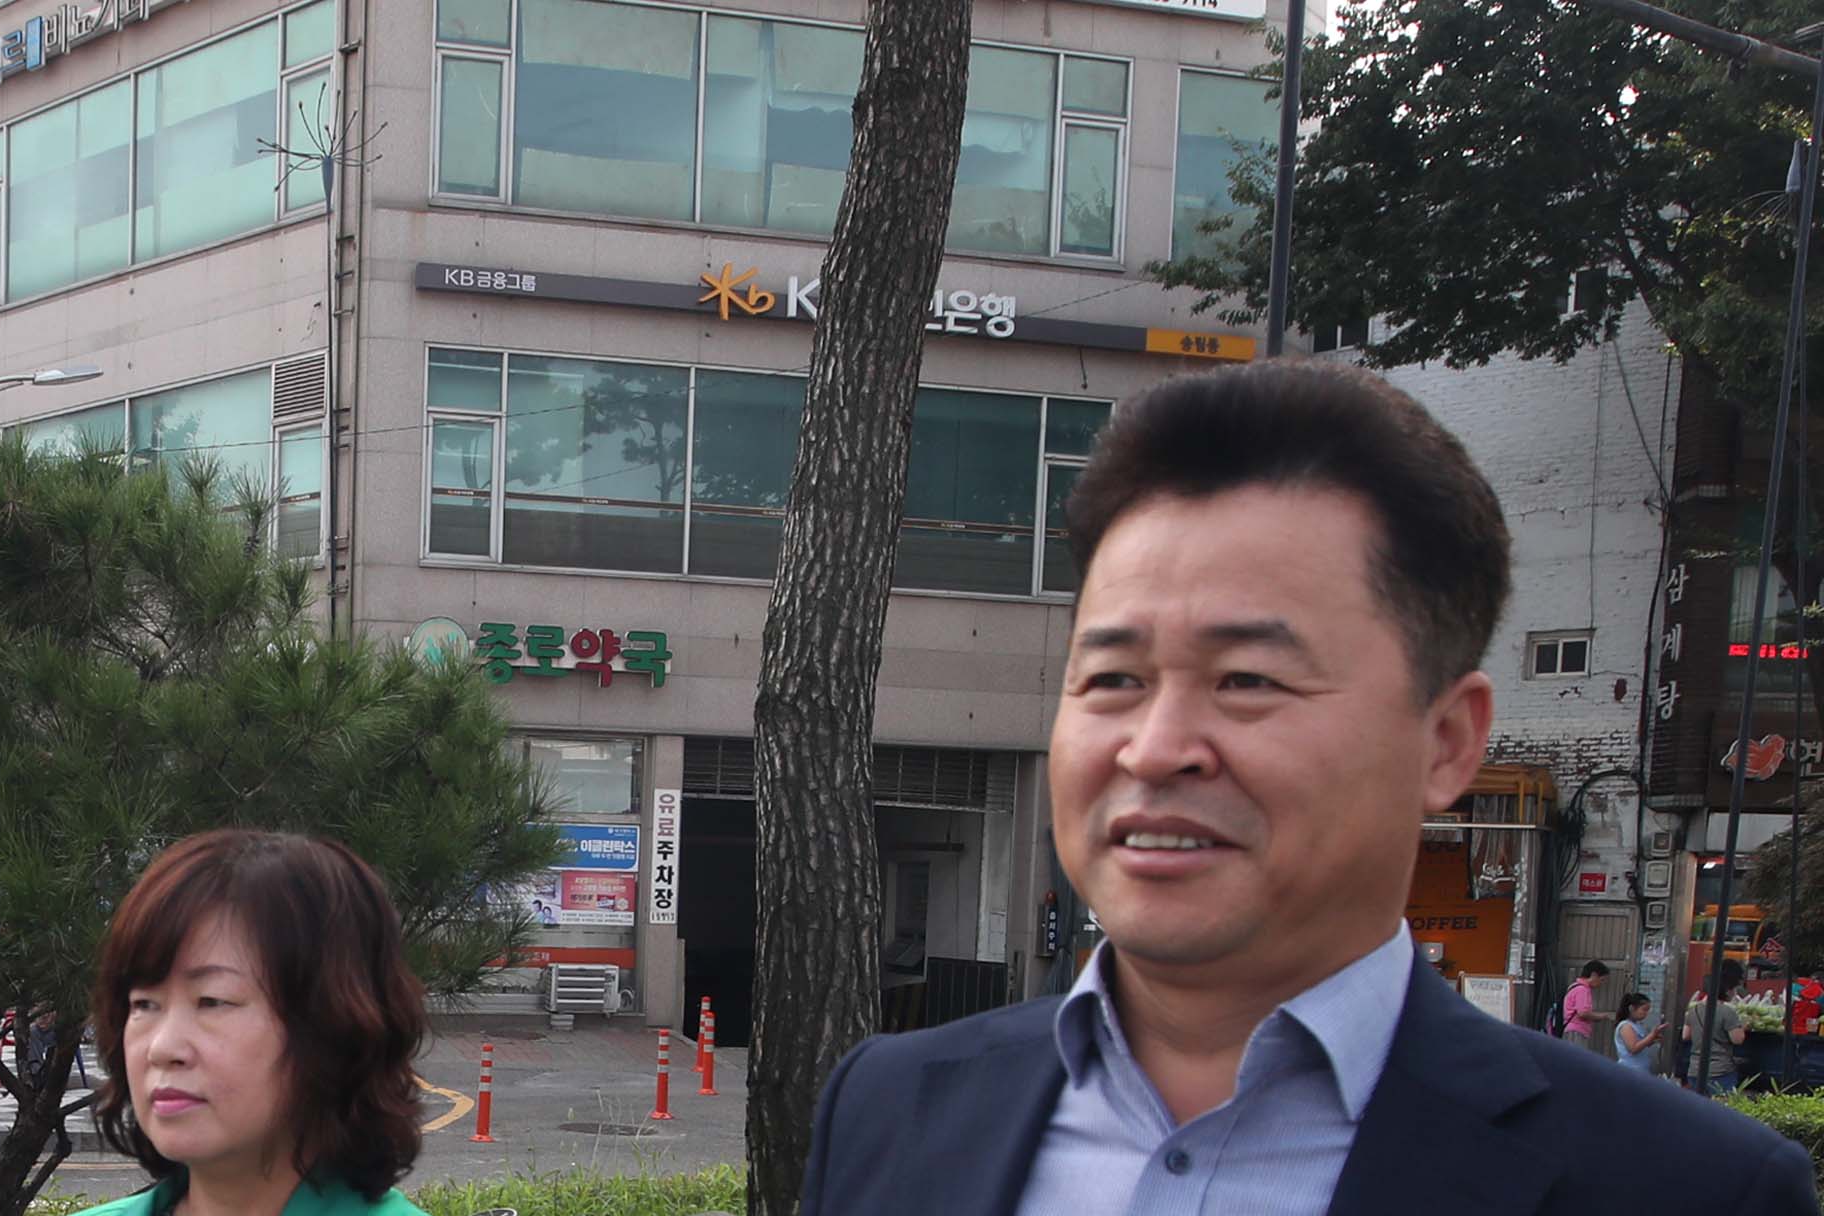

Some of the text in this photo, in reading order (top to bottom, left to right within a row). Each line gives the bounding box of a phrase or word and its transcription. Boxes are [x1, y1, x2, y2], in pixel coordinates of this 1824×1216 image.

[444, 268, 537, 292] KB금융그룹
[475, 622, 673, 689] 종로약국
[1658, 564, 1689, 720] 삼계탕
[655, 793, 675, 909] 유료주차장
[1412, 916, 1478, 930] OFFEE
